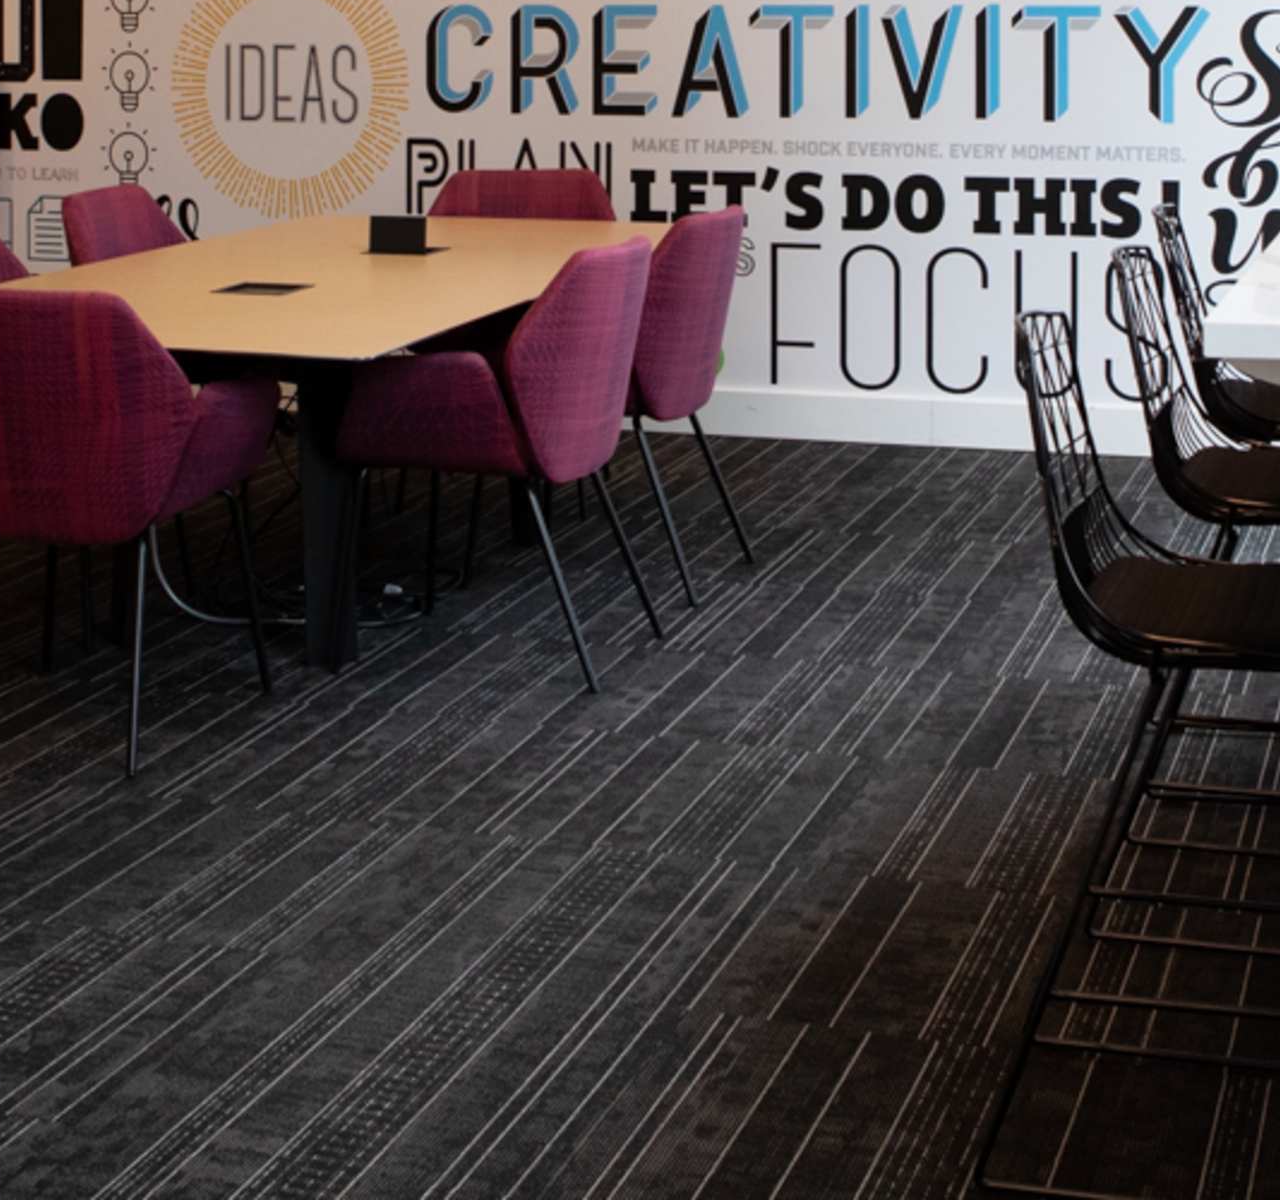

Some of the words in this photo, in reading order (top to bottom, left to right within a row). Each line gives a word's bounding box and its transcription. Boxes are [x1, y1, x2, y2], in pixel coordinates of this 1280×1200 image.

[224, 44, 360, 124] IDEAS
[425, 4, 1211, 124] CREATIVITY
[6, 167, 28, 181] TO
[32, 167, 80, 182] LEARN
[631, 136, 681, 154] MAKE
[685, 137, 700, 154] IT
[704, 137, 778, 156] HAPPEN.
[782, 139, 842, 157] SHOCK
[847, 140, 944, 159] EVERYONE.
[949, 142, 1007, 160] EVERY
[1012, 143, 1093, 162] MOMENT
[1095, 144, 1187, 164] MATTERS.
[630, 167, 824, 232] LET'S
[841, 173, 946, 234] DO
[770, 243, 1171, 404] FOCUS
